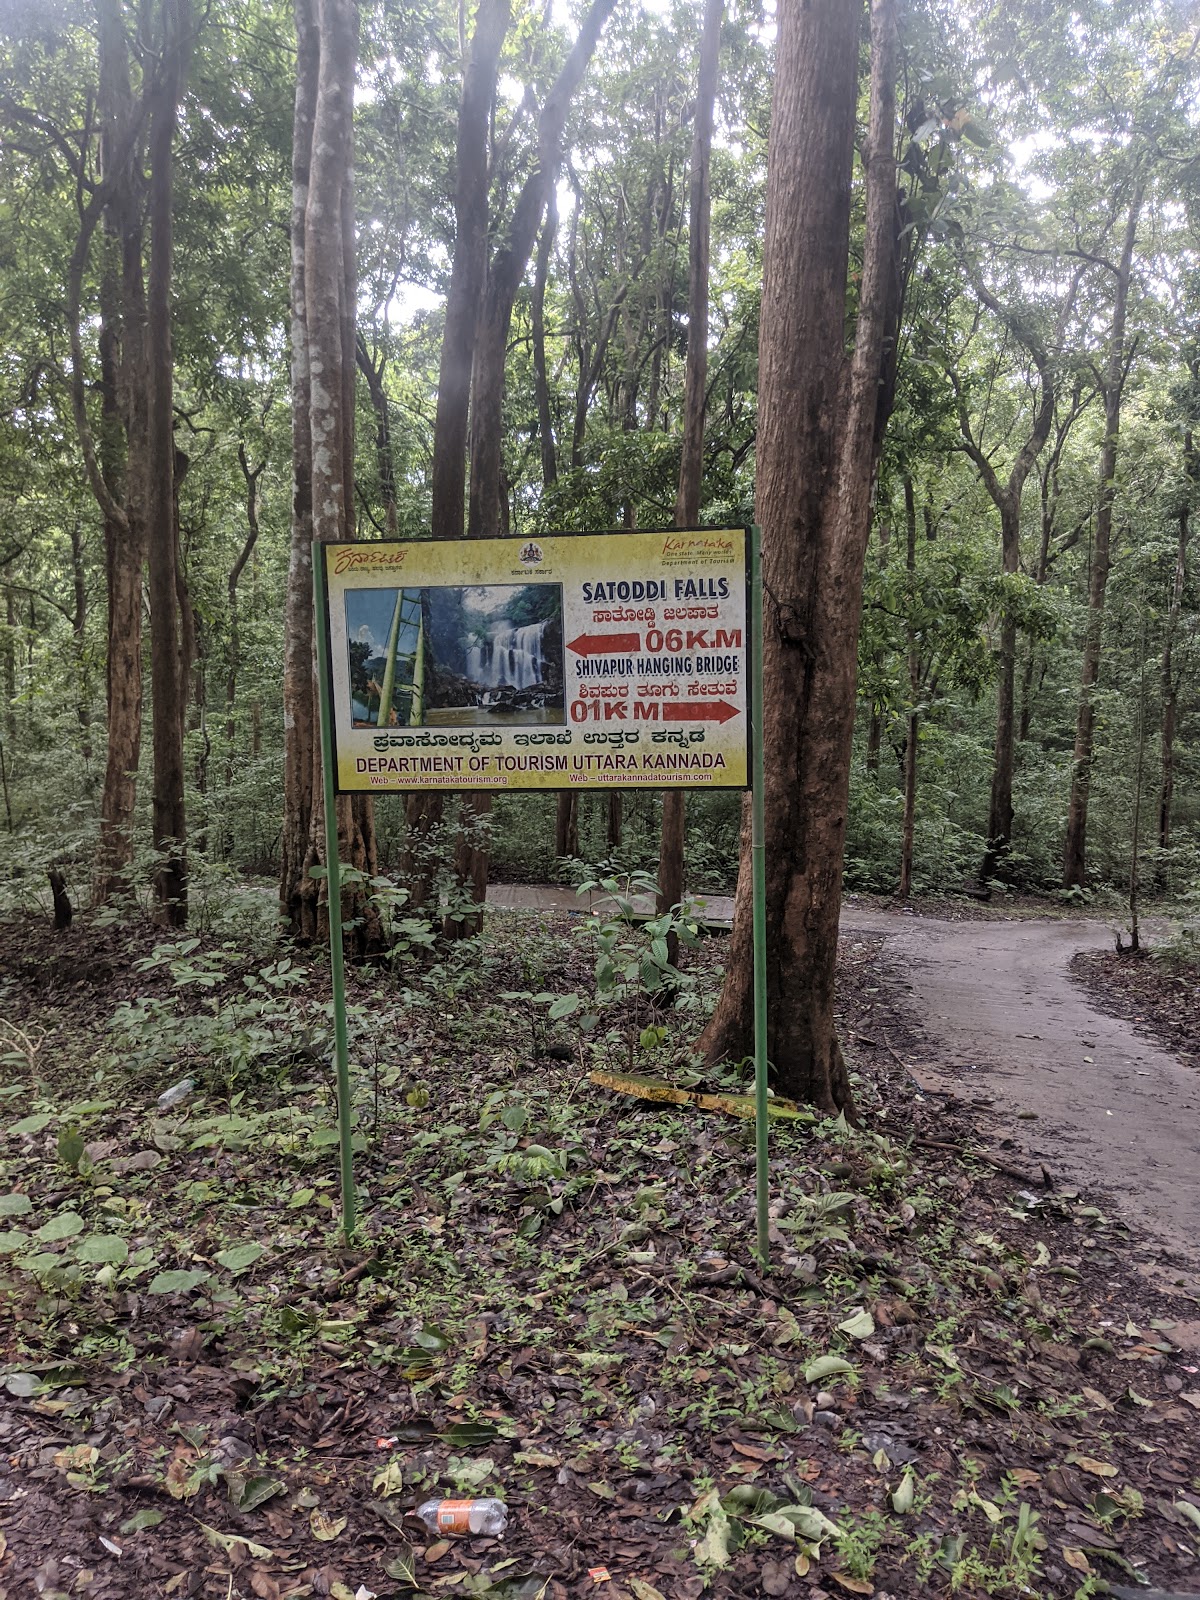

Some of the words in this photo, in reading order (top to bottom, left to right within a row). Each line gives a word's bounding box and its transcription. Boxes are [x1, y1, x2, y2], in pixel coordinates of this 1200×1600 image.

[662, 536, 734, 554] Karnataka
[661, 559, 698, 567] Department
[582, 580, 667, 603] SATODDI
[674, 577, 730, 599] FALLS
[663, 603, 719, 620] ಜಲಪಾತ
[575, 658, 634, 678] SHIVAPUR
[637, 656, 693, 676] HANGING
[696, 655, 740, 675] BRIDGE
[579, 682, 630, 698] ಶಿವಪುರ
[636, 681, 680, 698] ತೂಗು
[687, 679, 738, 696] ಸೇತುವೆ
[373, 731, 503, 753] ಪ್ರವಾಸೋದ್ಯಮ
[513, 730, 572, 746] ಇಲಾಖೆ
[583, 728, 640, 748] ಉತ್ತರ
[651, 727, 705, 748] ಕನ್ನಡ
[356, 756, 464, 773] DEPARTMENT
[469, 756, 490, 771] OF
[495, 755, 568, 771] TOURISM
[573, 754, 638, 770] UTTARA
[642, 753, 726, 769] KANNADA
[370, 776, 389, 784] Web
[397, 775, 508, 785] www.karnatakatourism.org
[569, 774, 589, 782] Web
[597, 773, 712, 782] uttarakannadatourism.com
